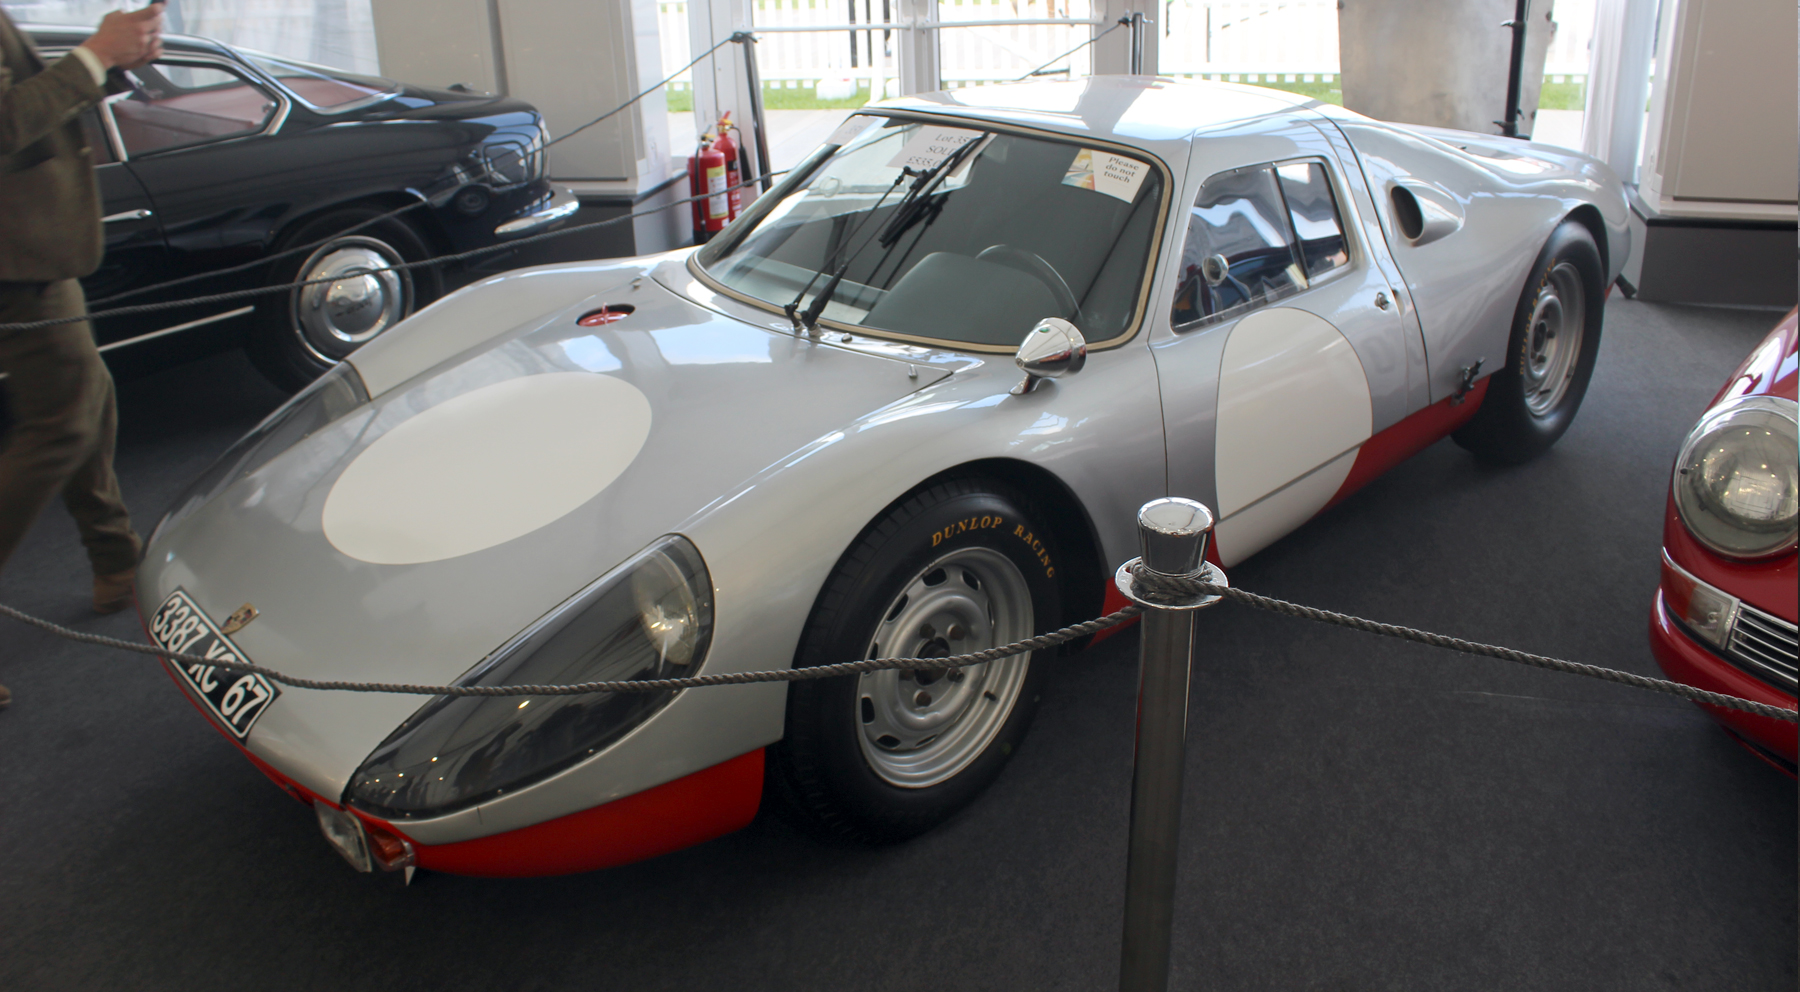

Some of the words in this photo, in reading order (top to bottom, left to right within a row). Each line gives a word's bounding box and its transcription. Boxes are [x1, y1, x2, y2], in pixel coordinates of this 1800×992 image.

[935, 133, 954, 143] Lot
[1105, 163, 1118, 172] do
[1119, 167, 1136, 178] not
[1108, 156, 1139, 171] Please
[1103, 170, 1130, 184] touch
[932, 515, 1003, 548] DUNLOP
[1013, 524, 1055, 578] RACING
[152, 596, 211, 656] 3387
[220, 674, 269, 726] 67
